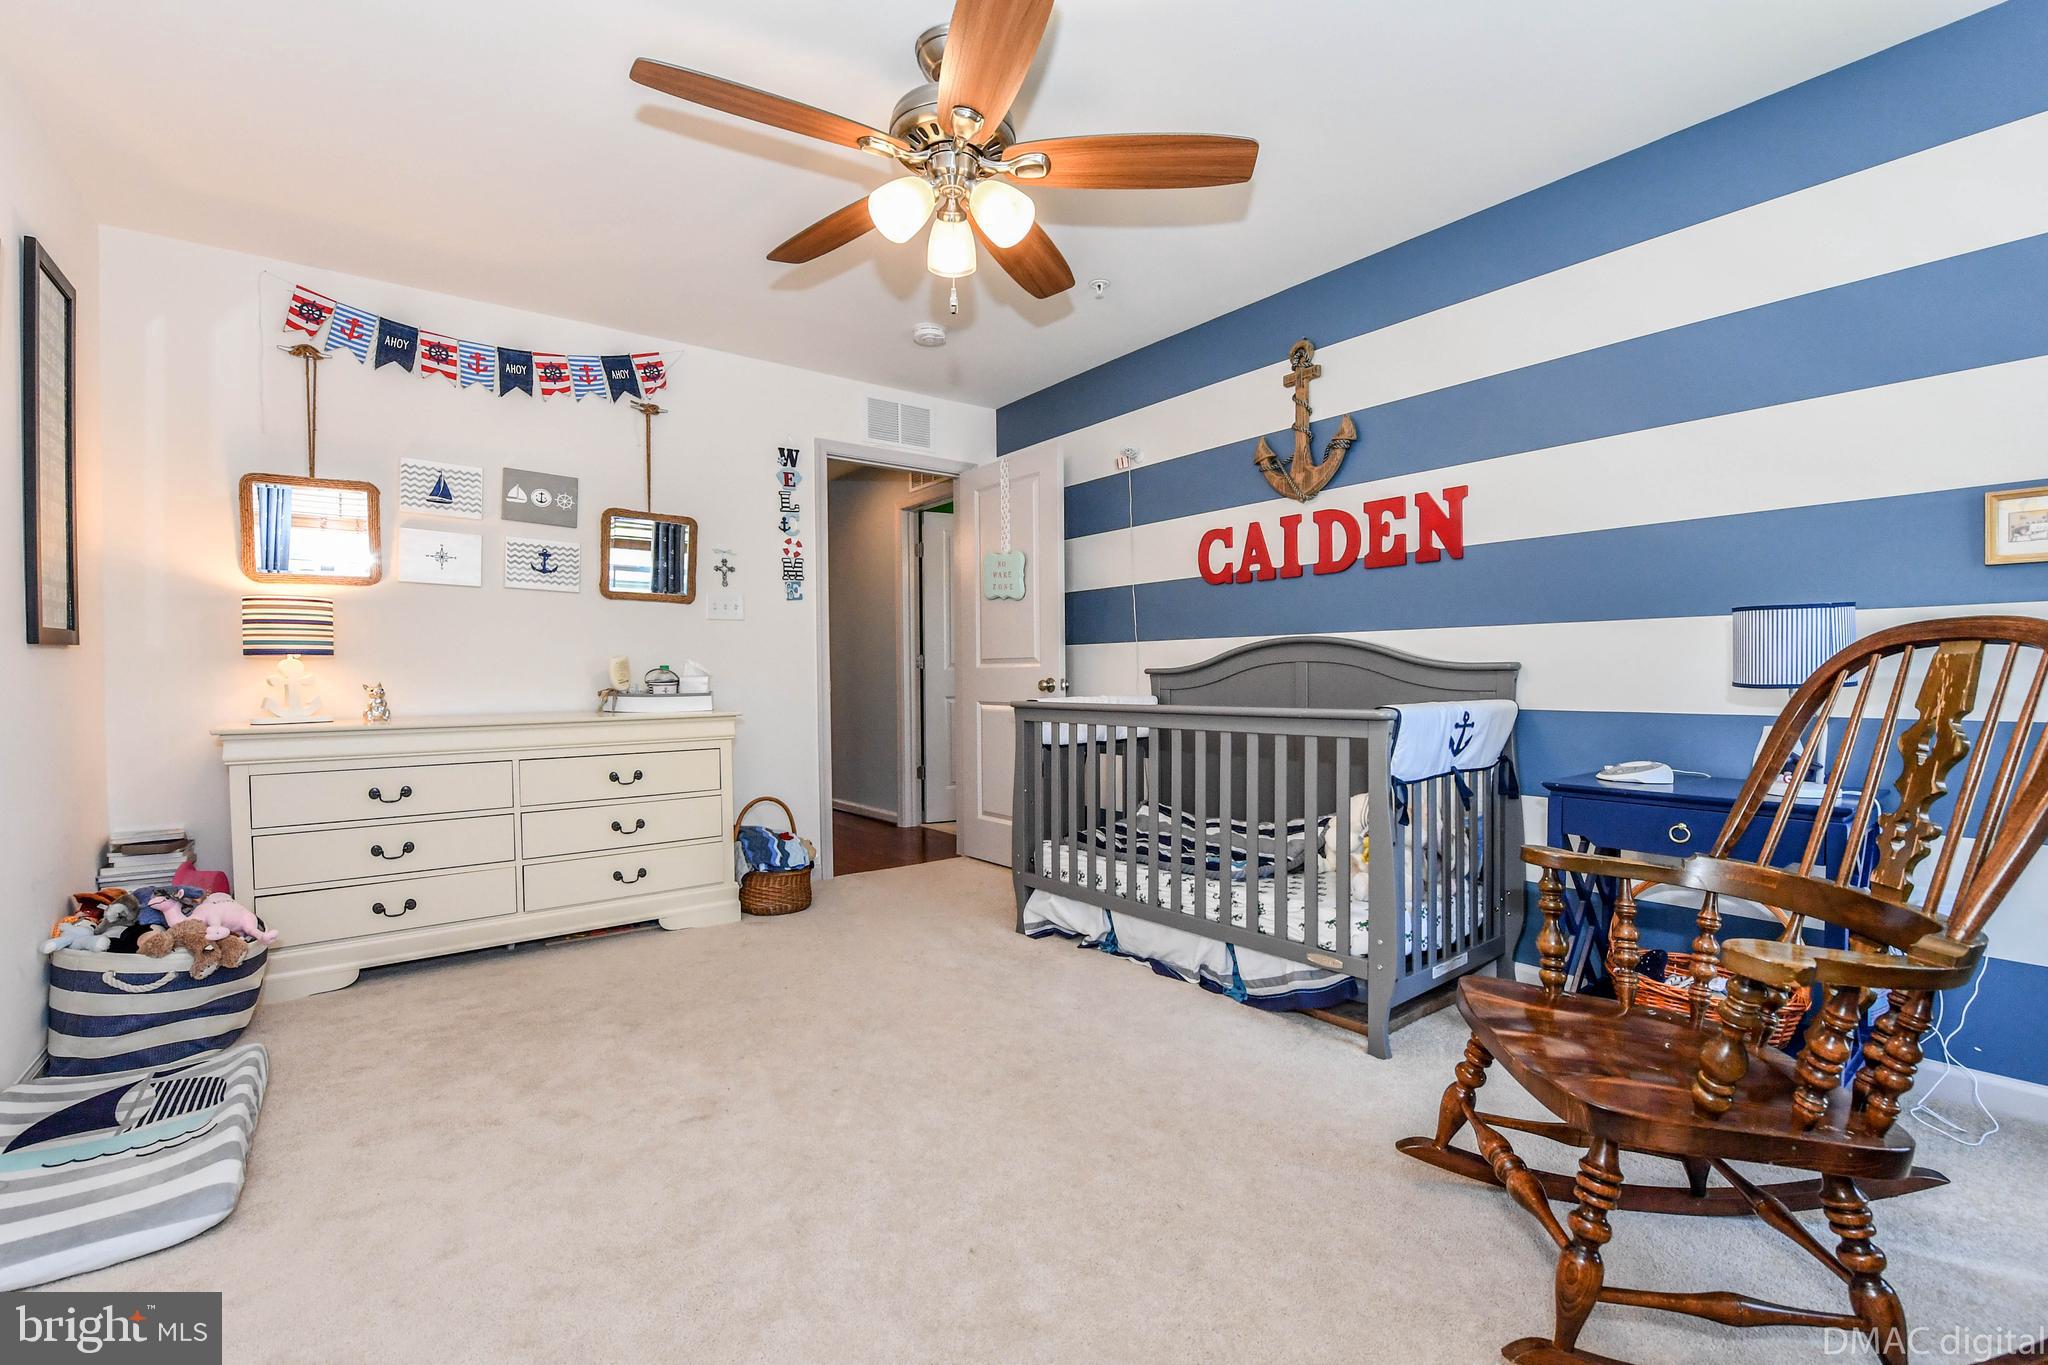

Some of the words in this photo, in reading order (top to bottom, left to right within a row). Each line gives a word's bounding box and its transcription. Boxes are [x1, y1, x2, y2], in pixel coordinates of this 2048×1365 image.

[384, 335, 410, 350] AHOY
[505, 363, 527, 375] AHOY
[611, 369, 630, 380] AHOY
[1198, 485, 1468, 585] CAIDEN
[997, 560, 1007, 568] NO
[992, 570, 1012, 578] WAKE
[992, 583, 1013, 591] ZONE
